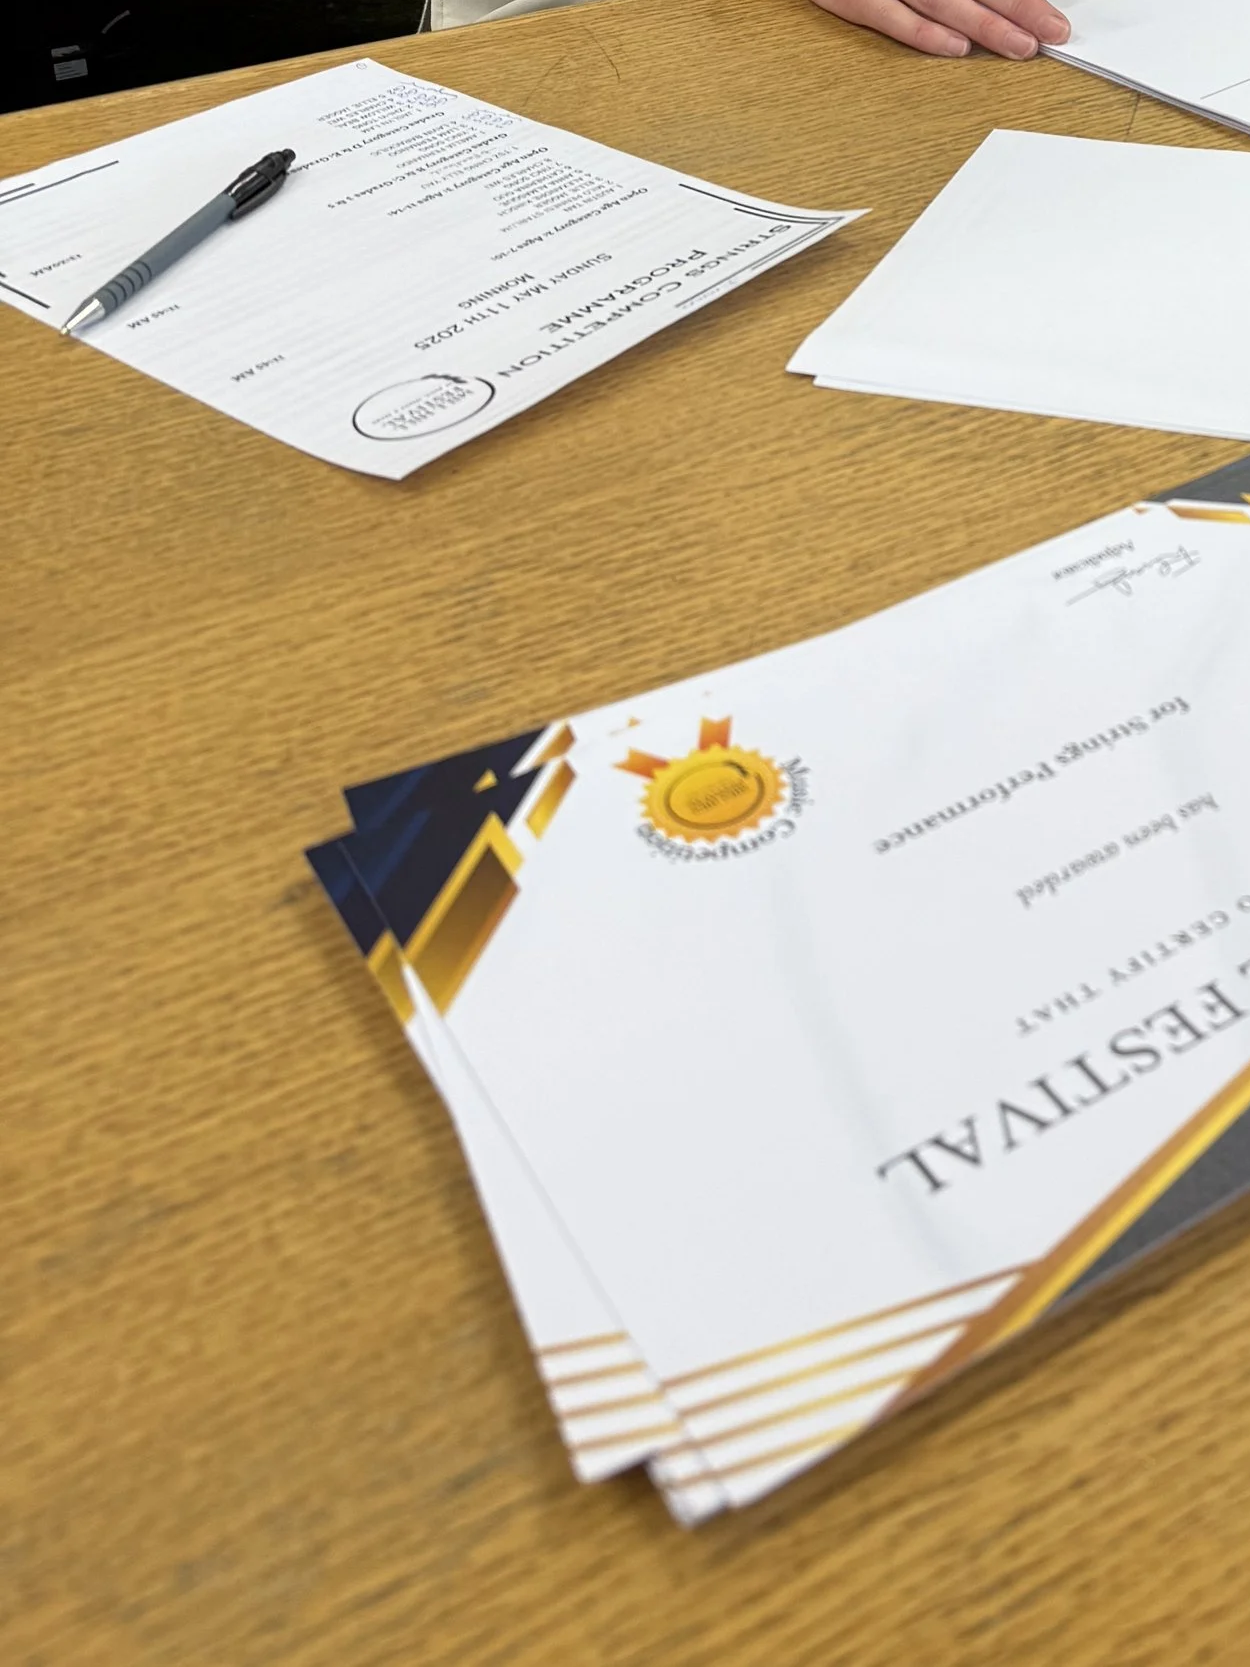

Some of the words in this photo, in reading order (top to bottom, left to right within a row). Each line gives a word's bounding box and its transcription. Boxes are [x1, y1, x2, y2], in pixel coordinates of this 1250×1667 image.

[408, 112, 444, 126] Grades
[363, 126, 409, 145] Category
[471, 134, 507, 149] Grades
[420, 148, 472, 168] Category
[501, 159, 520, 168] Age
[520, 148, 548, 159] Open
[354, 181, 393, 197] Grades
[454, 168, 501, 189] Category
[417, 192, 443, 204] Ages
[601, 200, 620, 210] Age
[620, 188, 648, 201] Open
[554, 210, 601, 232] Category
[517, 236, 543, 249] Ages
[685, 225, 791, 277] STRINGS
[549, 253, 612, 284] SUNDAY
[458, 273, 535, 309] MORNING
[513, 284, 549, 302] MAY
[540, 250, 707, 333] PROGRAMME
[127, 317, 150, 329] AM
[464, 303, 510, 325] 11TH
[414, 324, 464, 350] 2025
[498, 282, 682, 377] COMPETITION
[232, 369, 254, 382] AM
[1051, 538, 1136, 583] Adjudicator
[1149, 694, 1191, 724] for
[1053, 714, 1150, 766] Strings
[779, 755, 815, 818] Music
[873, 759, 1055, 855] Performance
[1178, 790, 1221, 817] has
[635, 818, 797, 864] Competition
[1126, 809, 1181, 849] been
[1013, 839, 1120, 911] awarded
[1107, 909, 1231, 986] CERTIFY
[1013, 980, 1104, 1038] THAT
[874, 978, 1250, 1197] FESTIVAL
